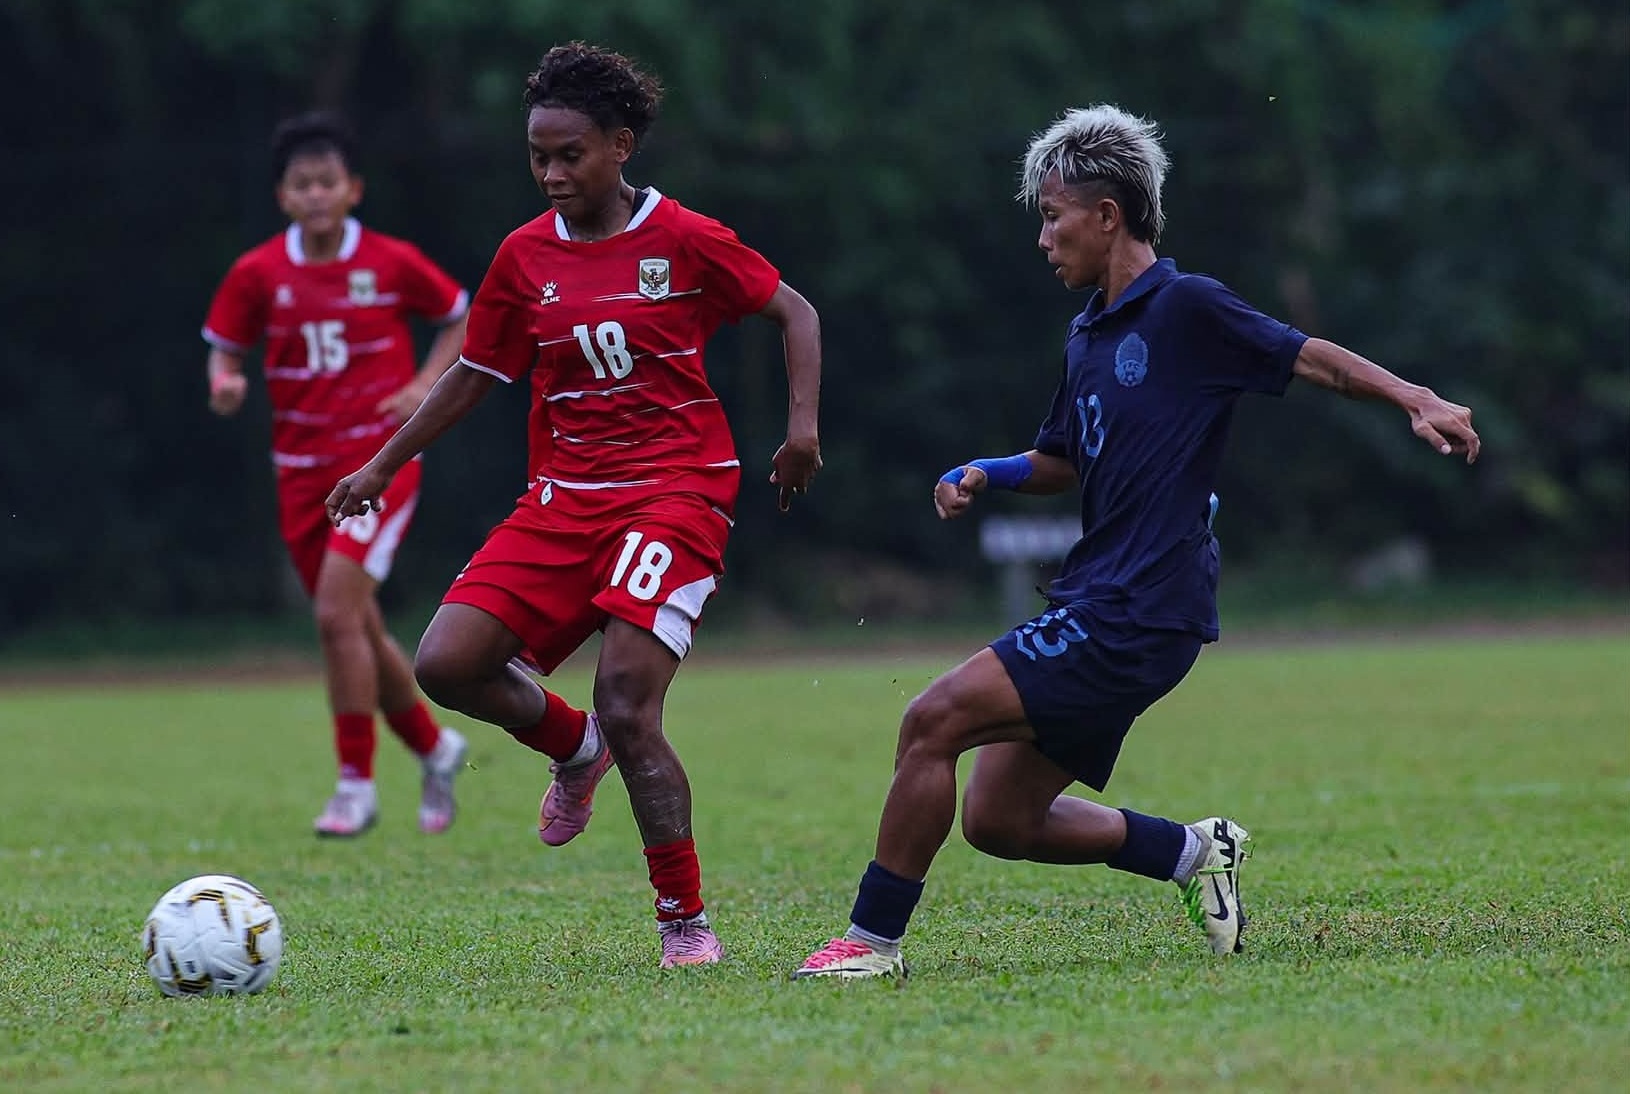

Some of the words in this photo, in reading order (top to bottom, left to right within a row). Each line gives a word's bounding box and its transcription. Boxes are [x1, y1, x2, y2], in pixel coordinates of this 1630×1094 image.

[301, 319, 349, 375] 15
[573, 321, 633, 379] 18
[610, 531, 673, 600] 18
